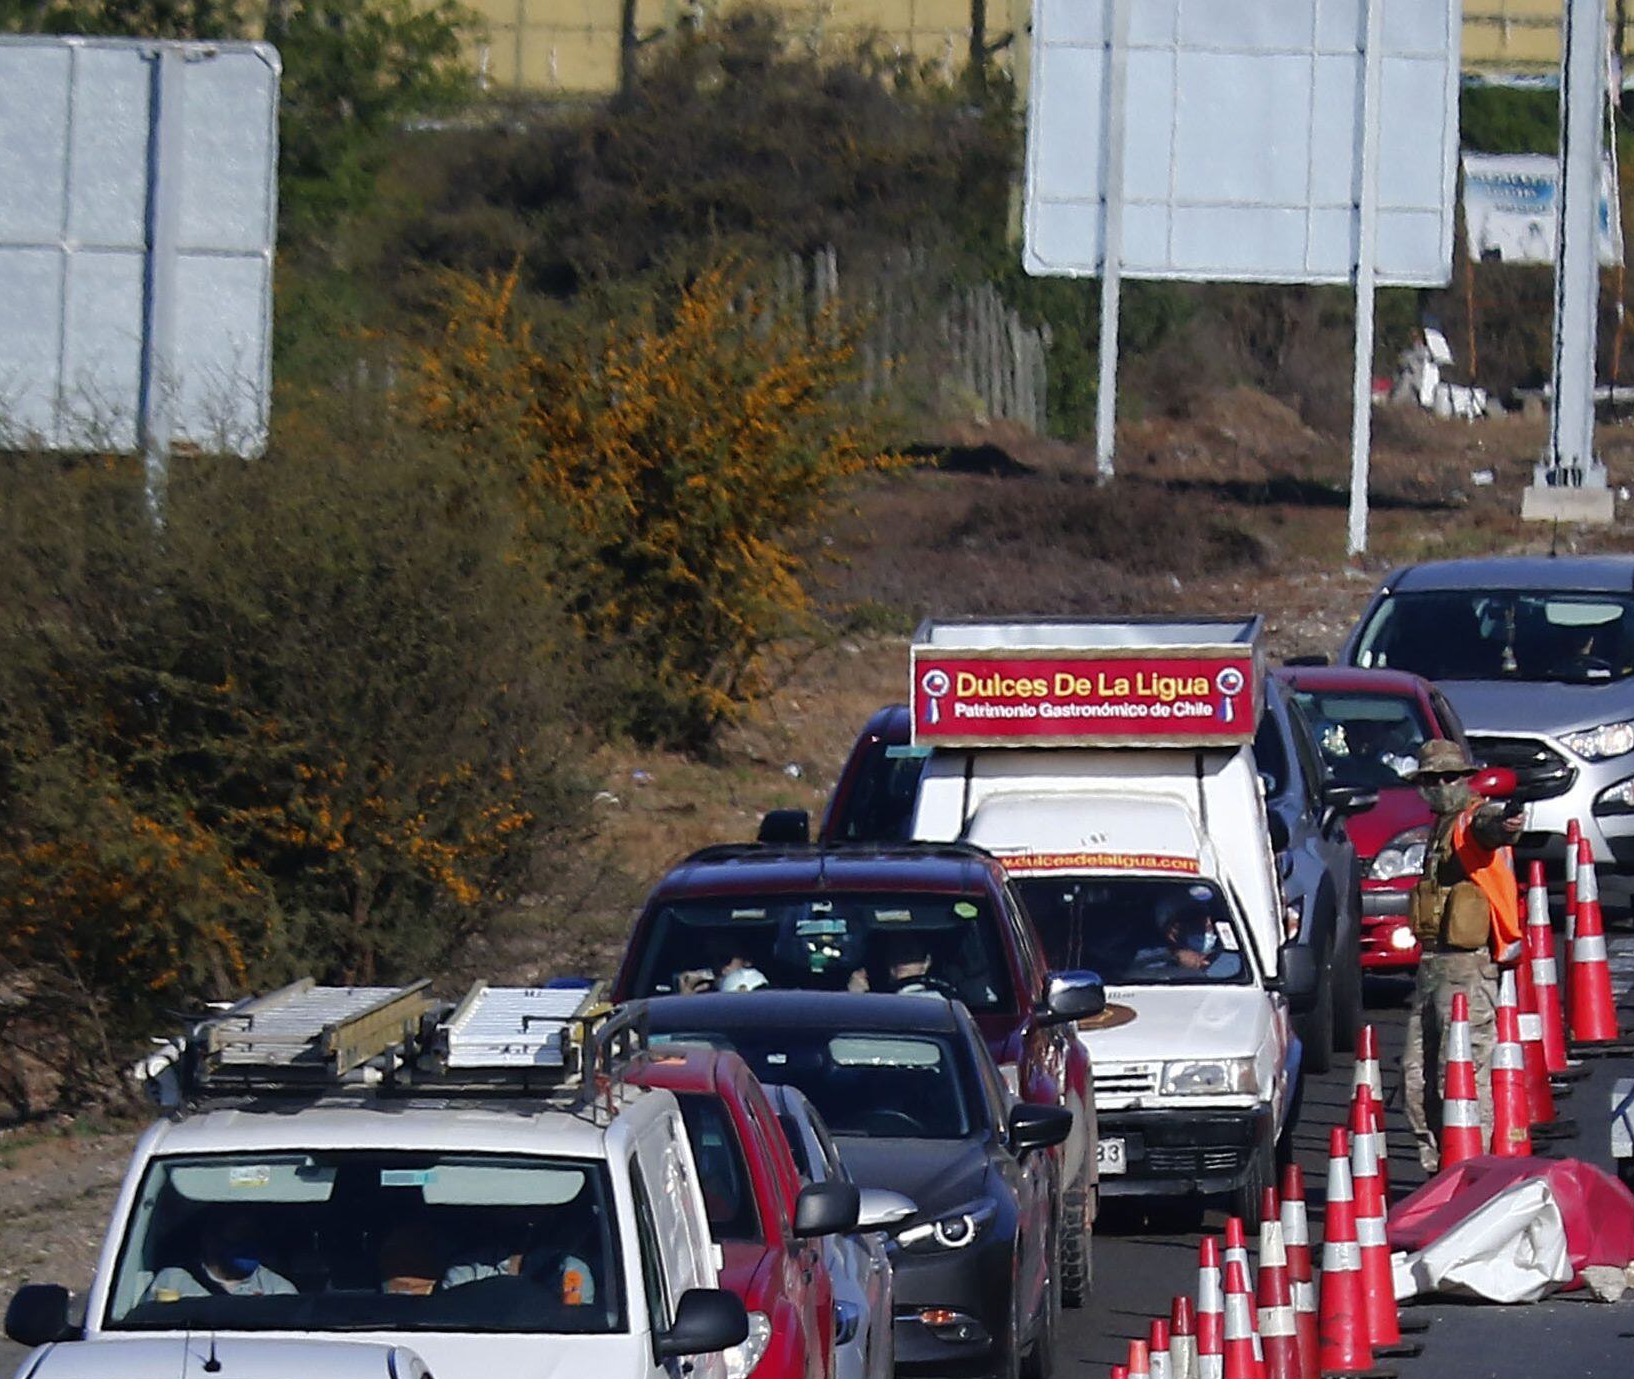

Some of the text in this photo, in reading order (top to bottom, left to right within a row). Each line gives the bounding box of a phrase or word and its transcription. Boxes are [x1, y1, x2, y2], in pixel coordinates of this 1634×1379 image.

[956, 671, 1209, 702] Dulces De La Ligua
[954, 701, 1213, 718] Patrimonio Gastronómico de Chile
